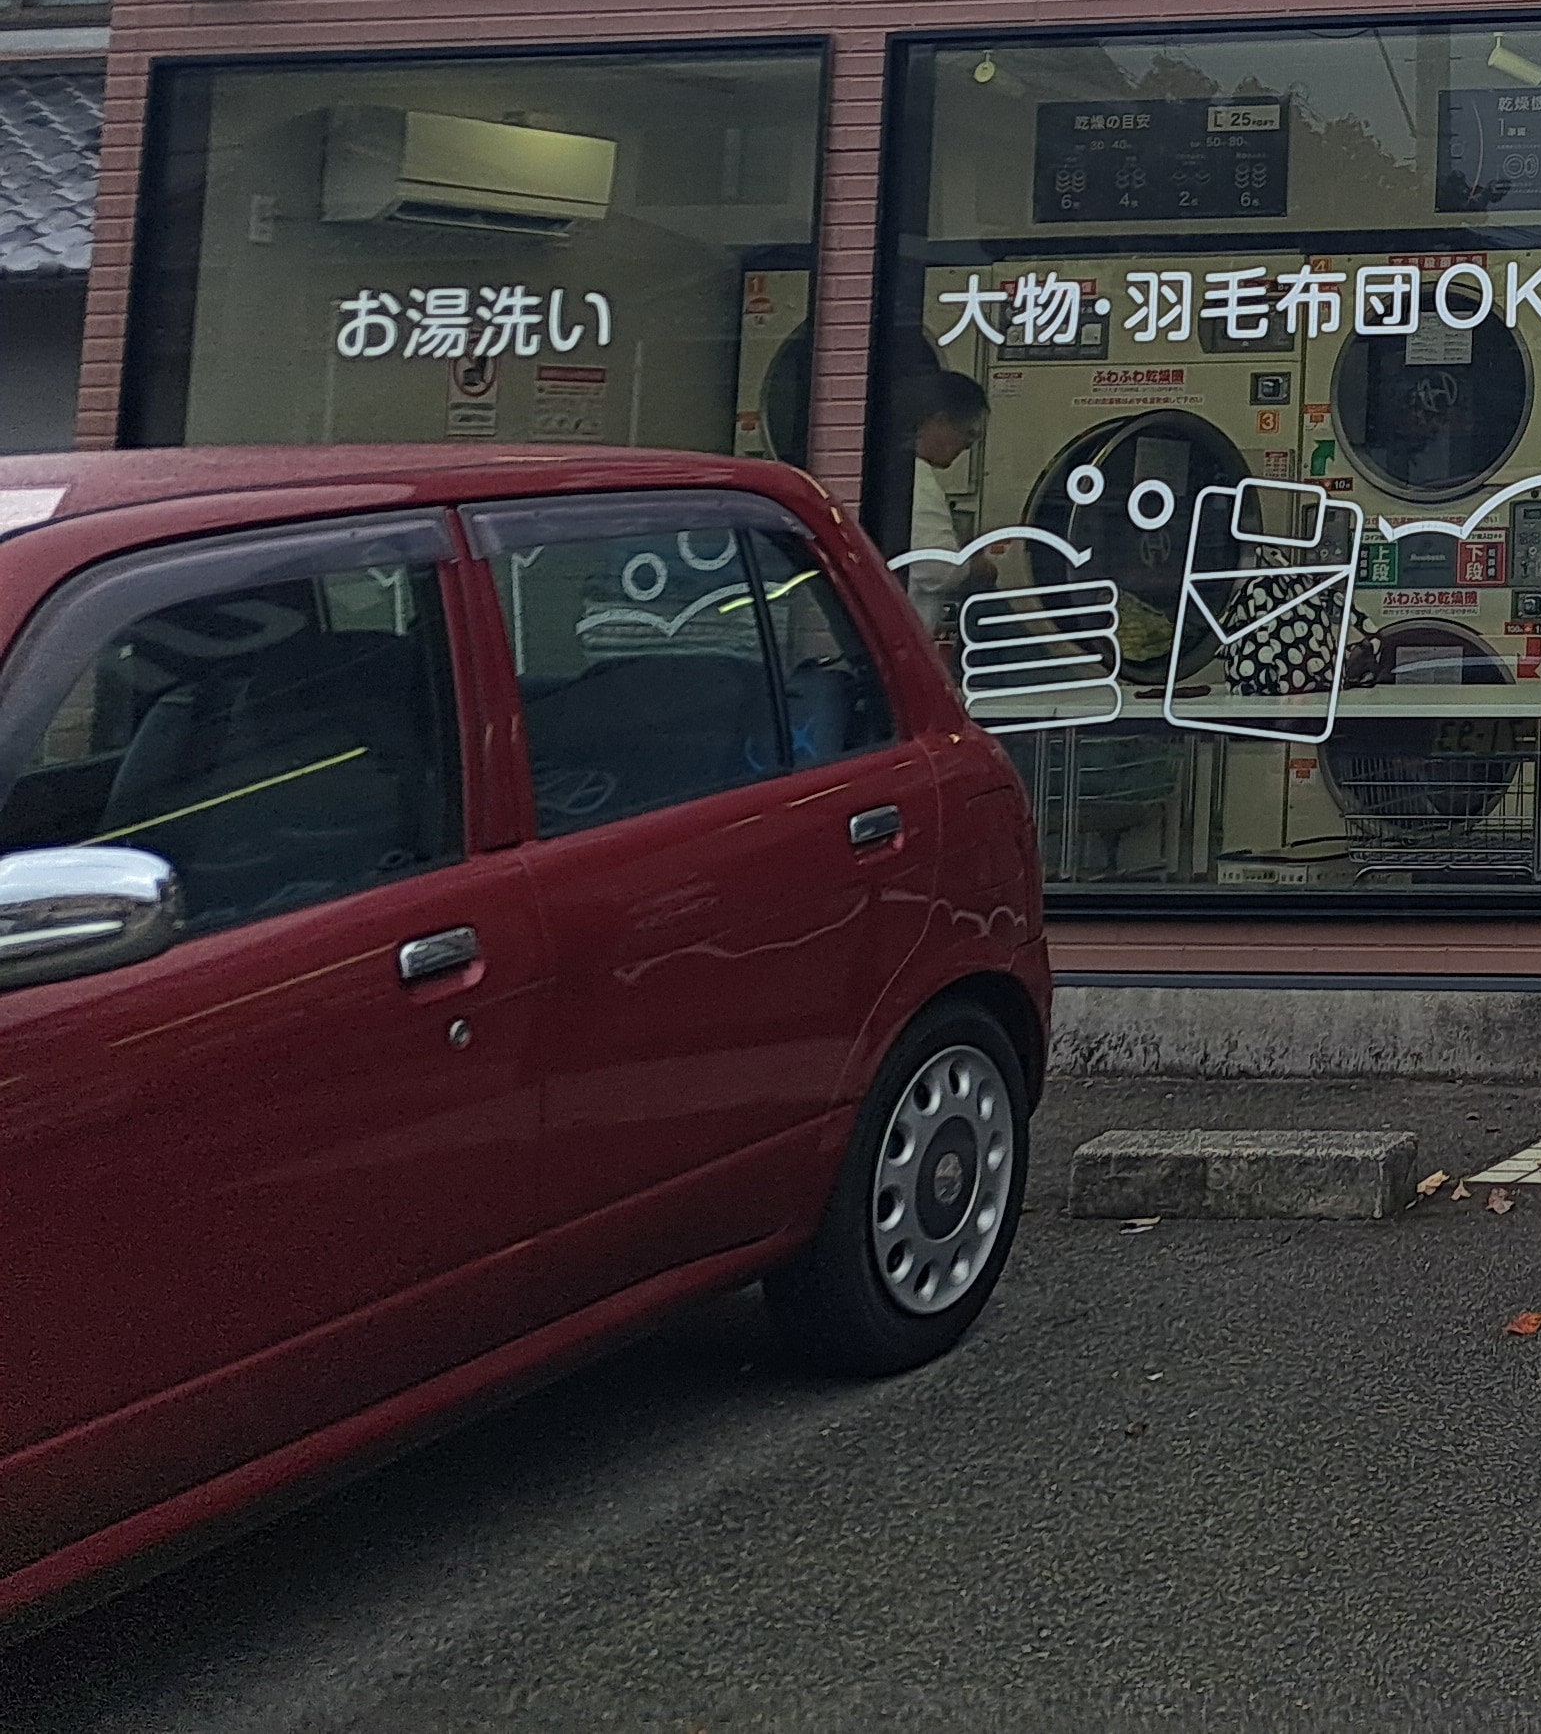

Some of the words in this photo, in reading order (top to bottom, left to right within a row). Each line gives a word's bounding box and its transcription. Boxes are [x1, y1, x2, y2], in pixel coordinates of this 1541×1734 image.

[336, 285, 611, 358] お湯洗い
[1260, 413, 1275, 431] 3
[1372, 545, 1390, 582] 上段
[1465, 544, 1484, 581] 下段
